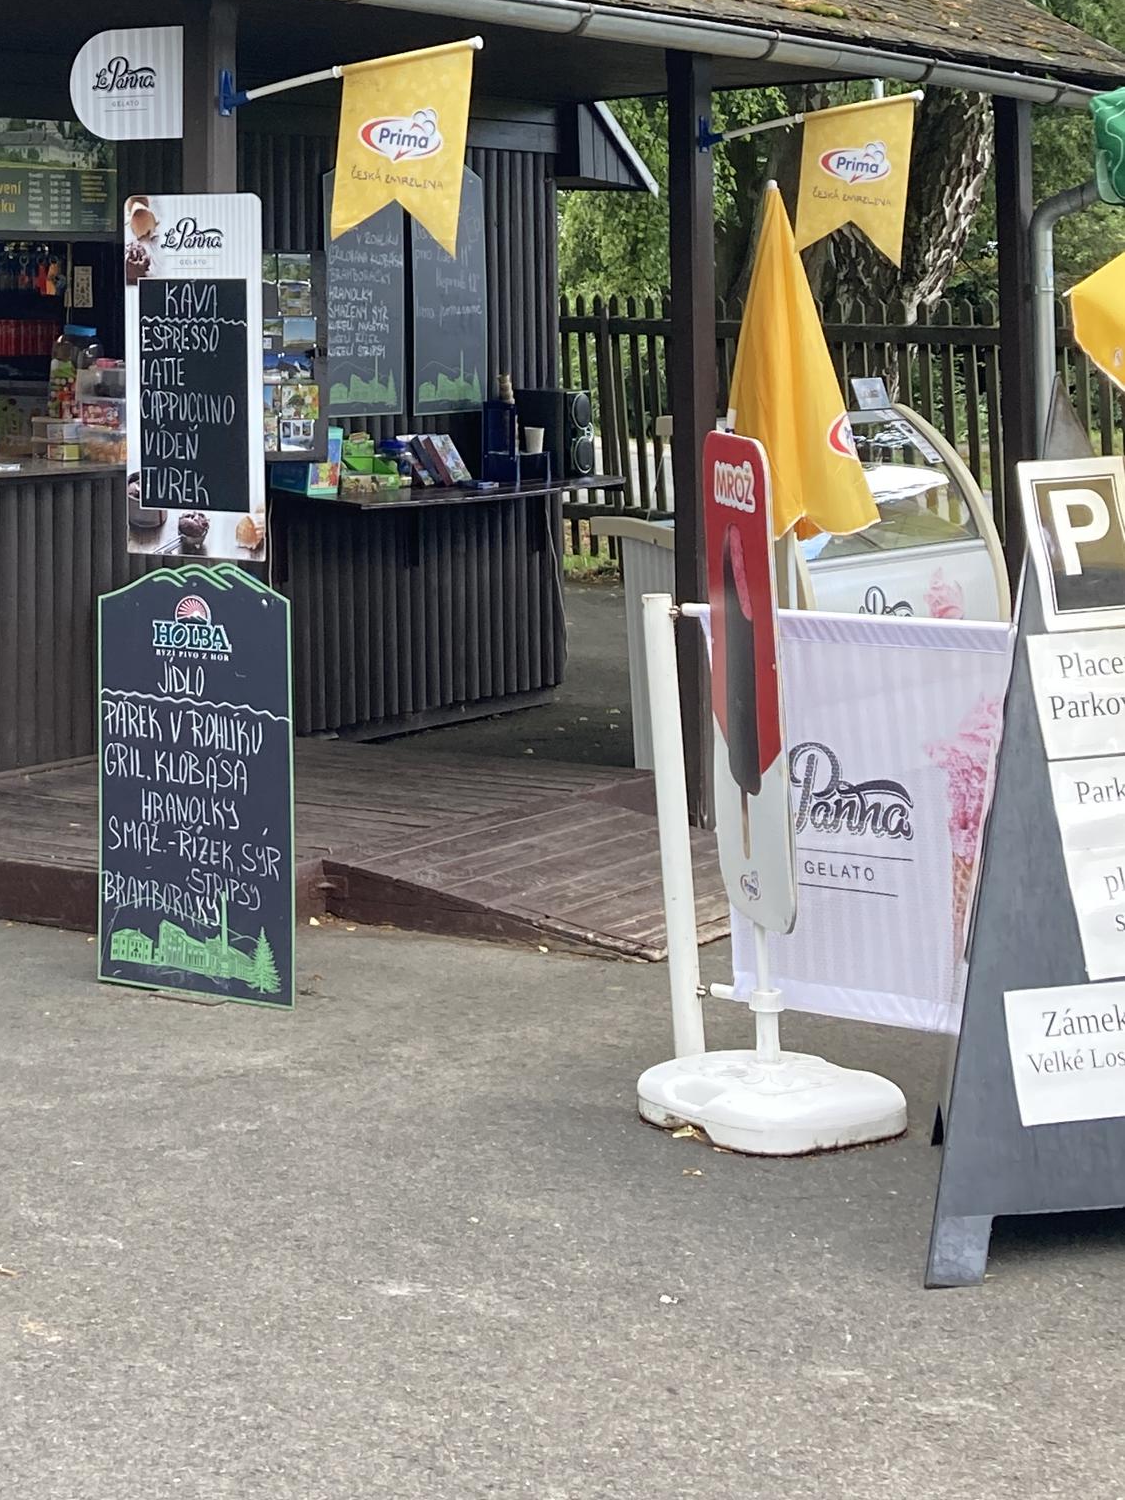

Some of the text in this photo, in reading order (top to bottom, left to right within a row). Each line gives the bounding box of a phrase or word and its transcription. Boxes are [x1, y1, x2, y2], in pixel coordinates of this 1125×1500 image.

[107, 56, 156, 92] Panna
[378, 127, 429, 149] Prima
[836, 156, 879, 174] Prima
[176, 216, 224, 251] Panna
[142, 324, 220, 353] ESPRESSO
[142, 358, 185, 388] LATTE
[140, 389, 235, 426] CAPPUCCINO
[144, 424, 199, 460] VÍDEŇ
[143, 466, 210, 506] TUREK
[715, 463, 754, 508] MROŽ
[1048, 488, 1111, 576] P
[152, 620, 232, 653] HOLBA
[179, 650, 199, 659] PIVO
[201, 652, 207, 660] Z
[210, 653, 230, 662] HOR
[1055, 652, 1125, 678] Place
[157, 657, 205, 697] JÍDLO
[102, 697, 263, 757] PÁREK V ROHLÍKU
[141, 788, 240, 830] HRANOLKY
[804, 860, 875, 881] GELATO
[1027, 1048, 1084, 1074] Velké
